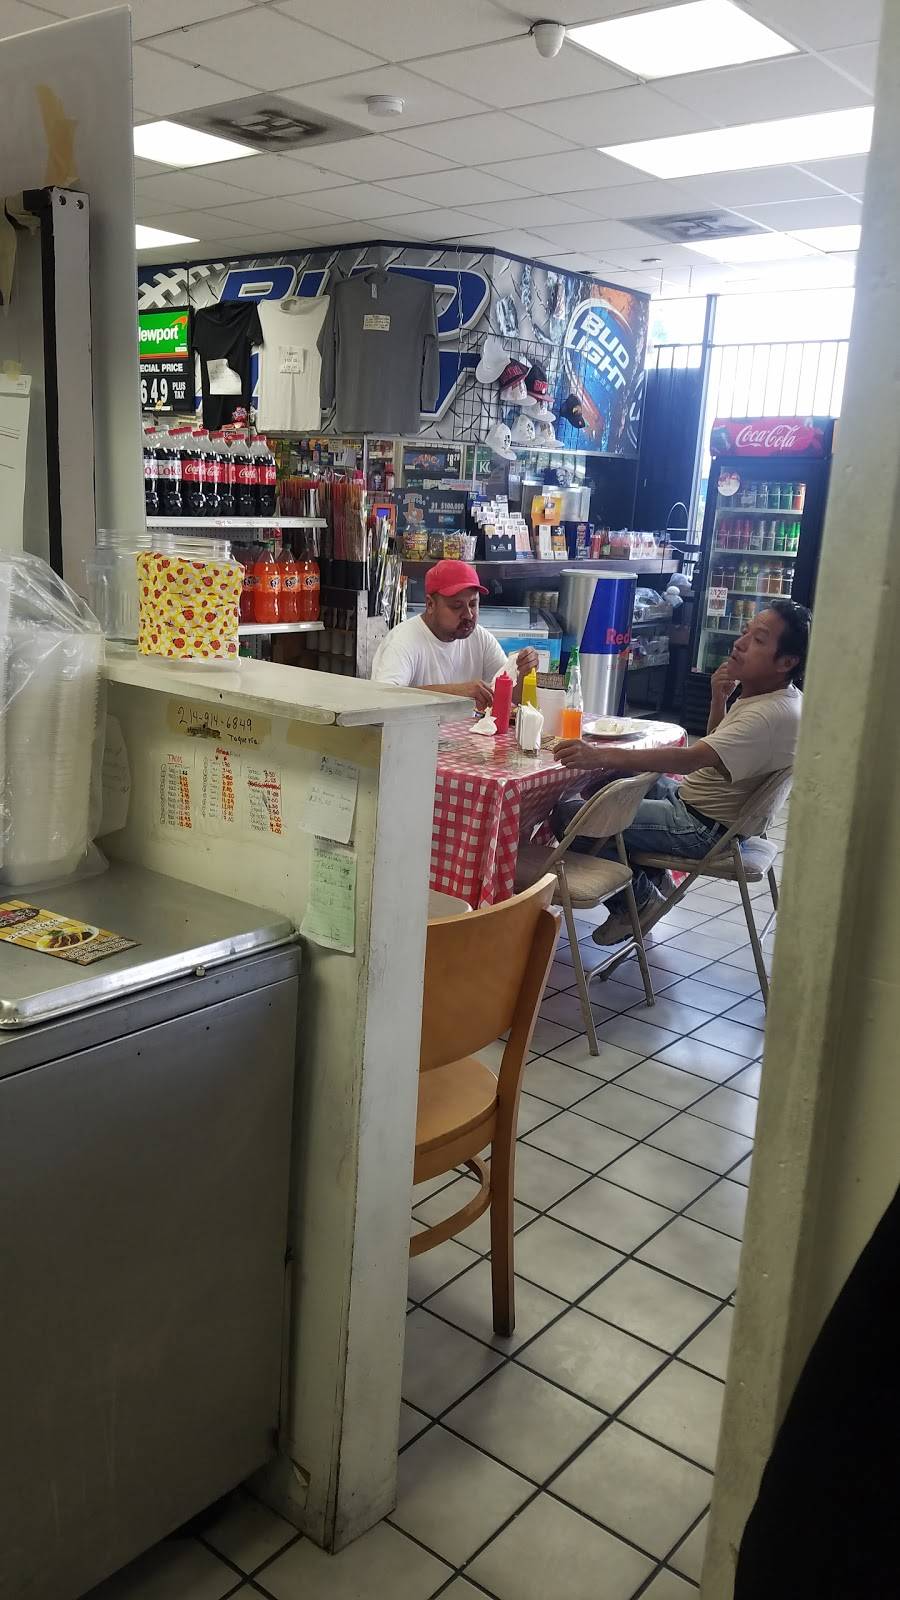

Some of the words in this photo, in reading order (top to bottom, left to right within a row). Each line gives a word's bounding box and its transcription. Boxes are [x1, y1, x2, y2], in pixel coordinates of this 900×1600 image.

[579, 310, 630, 370] BUD
[139, 364, 160, 373] ECIAL
[161, 363, 184, 372] PRICE
[566, 328, 626, 390] LIGHT
[140, 378, 168, 404] 6.49
[172, 381, 186, 391] PLUS
[174, 390, 185, 399] TAX
[606, 627, 630, 645] Red
[177, 706, 252, 732] 214-914-6849
